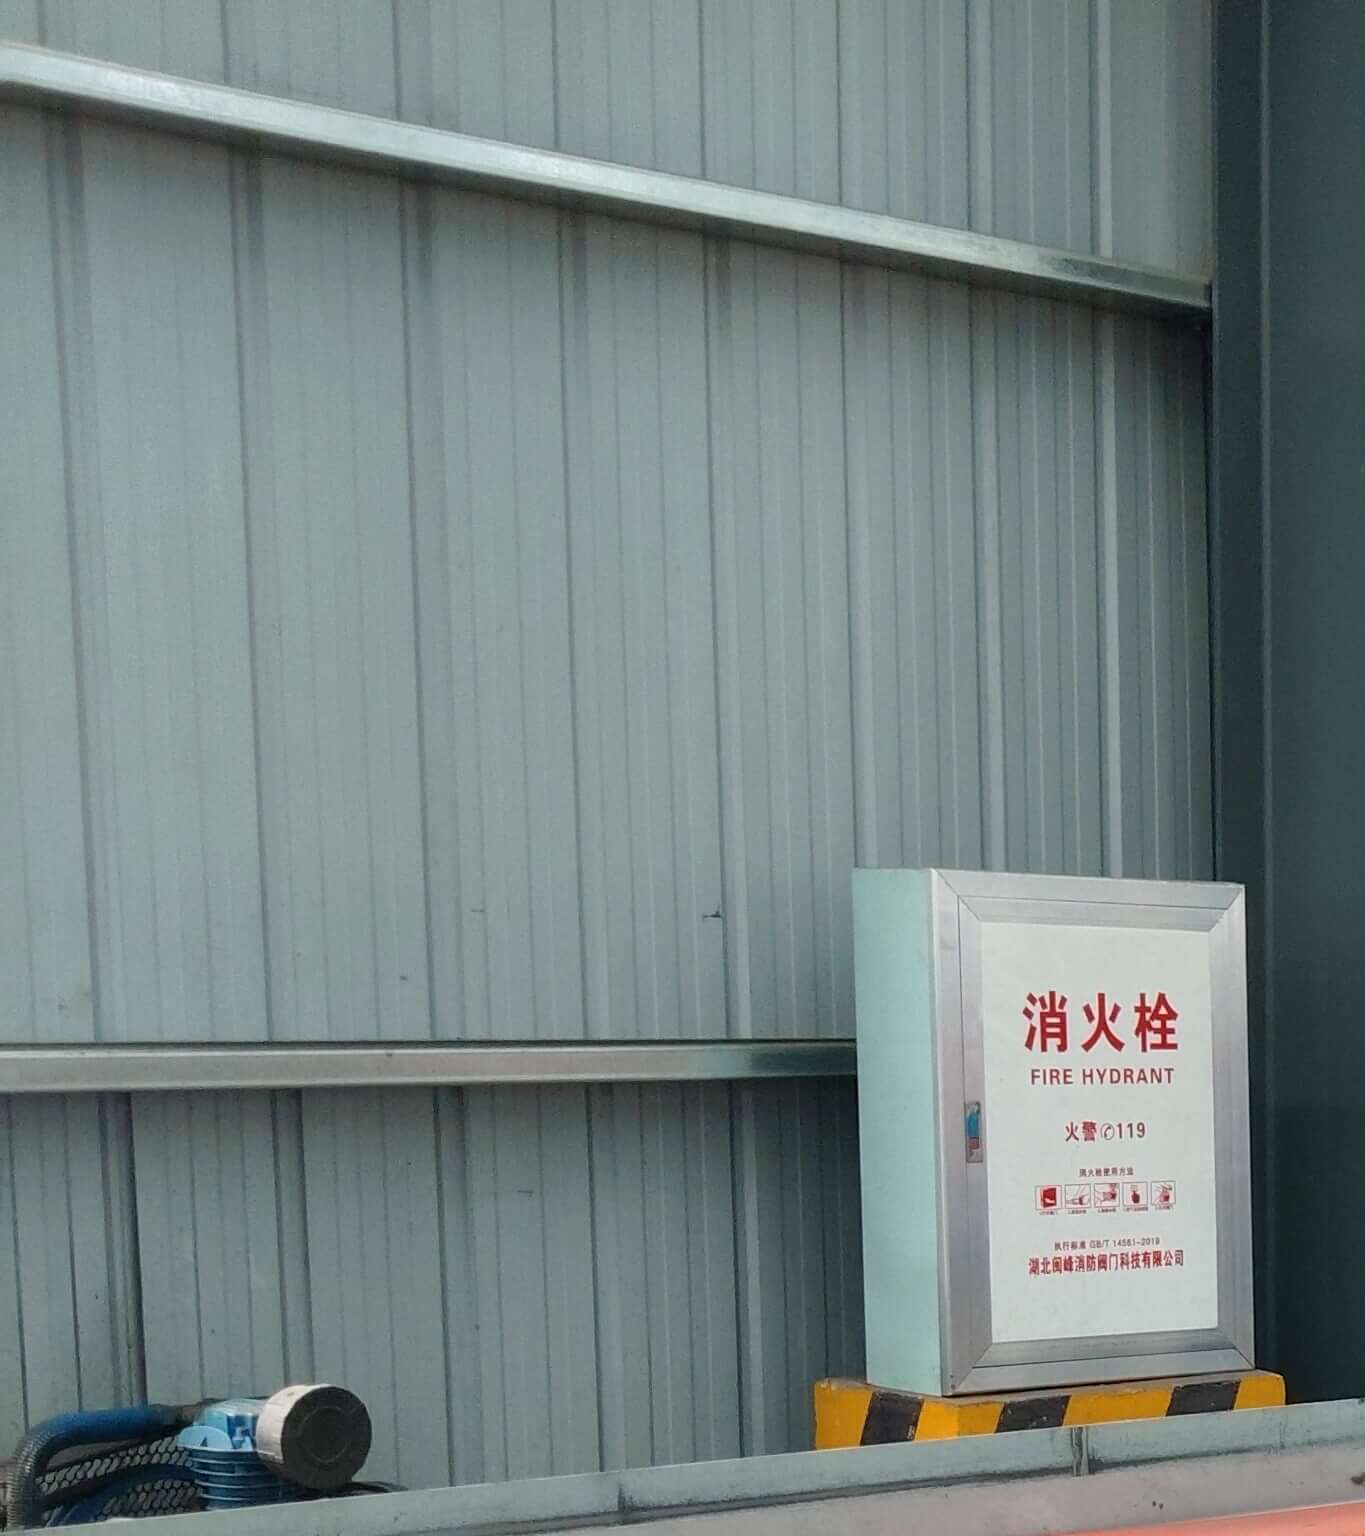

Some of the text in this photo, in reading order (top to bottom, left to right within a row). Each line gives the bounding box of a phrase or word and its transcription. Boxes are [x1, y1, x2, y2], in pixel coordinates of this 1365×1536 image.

[1022, 990, 1178, 1053] 消火栓
[1031, 1067, 1175, 1085] FIRE HYDRANT
[1065, 1121, 1146, 1142] 火警 119
